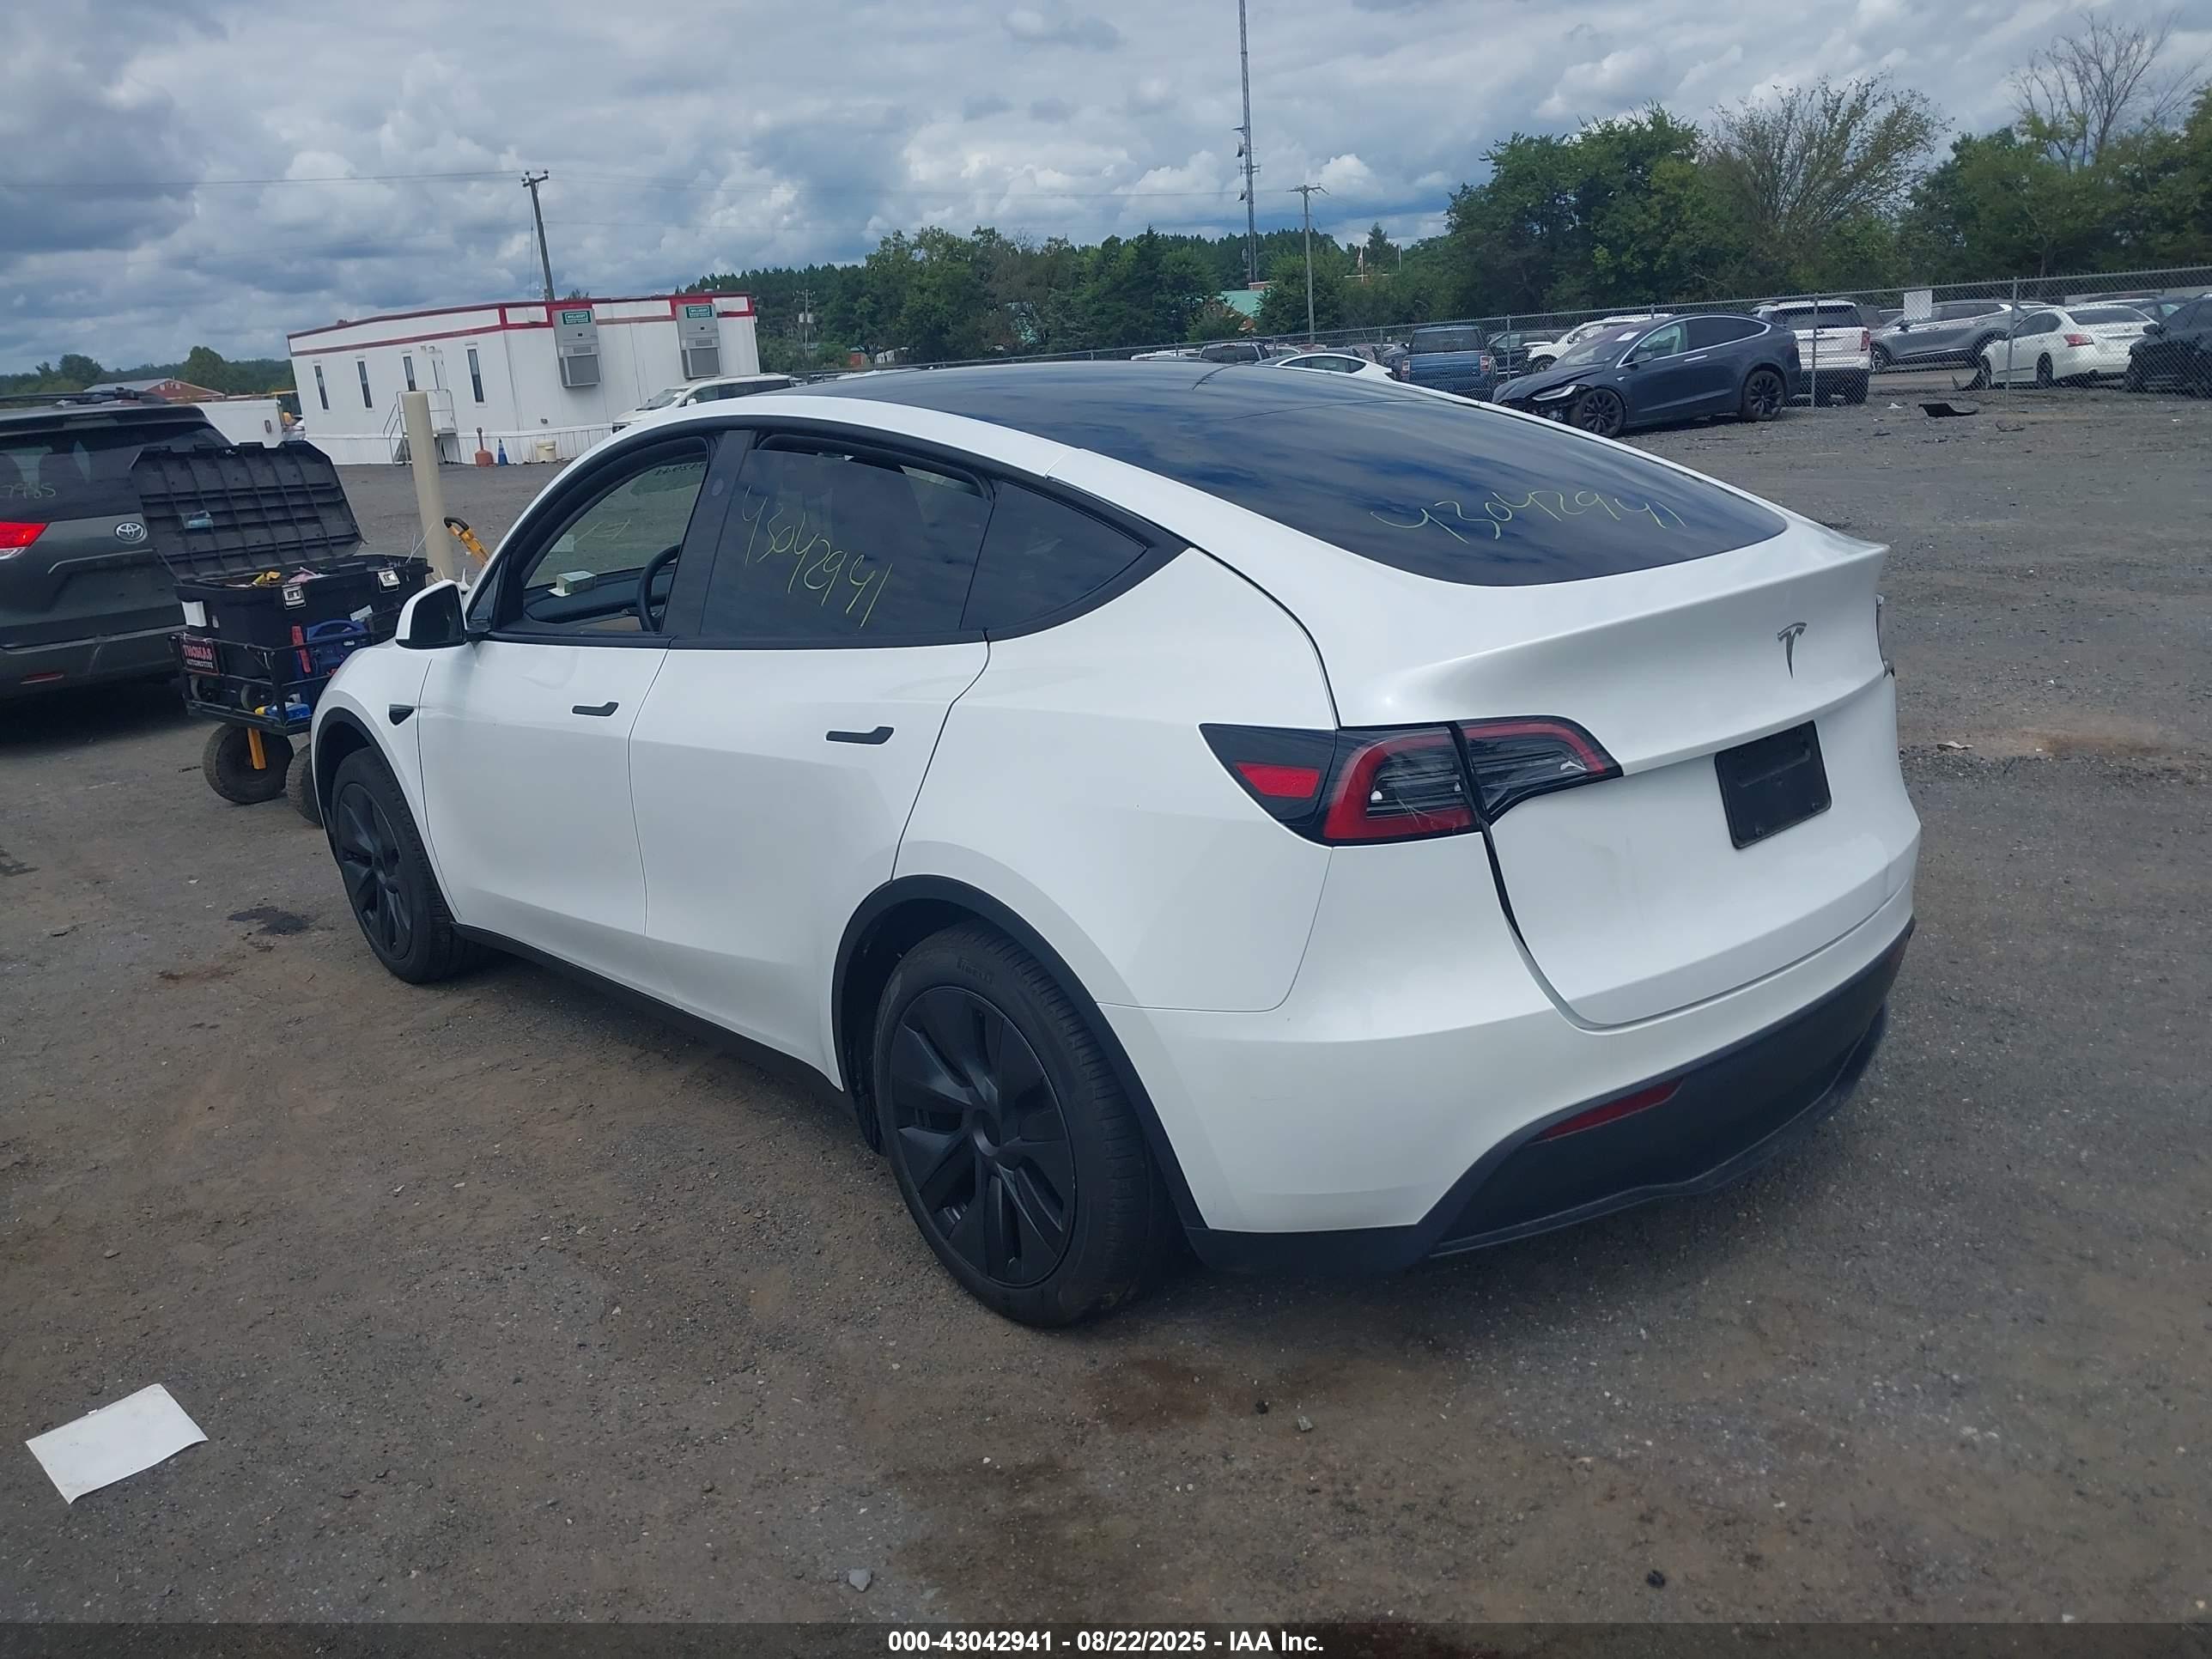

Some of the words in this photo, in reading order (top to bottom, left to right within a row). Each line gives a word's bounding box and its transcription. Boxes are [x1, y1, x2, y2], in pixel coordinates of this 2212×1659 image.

[1370, 489, 1688, 544] 43042941
[742, 484, 893, 629] 43042941
[182, 644, 213, 660] THOMAS
